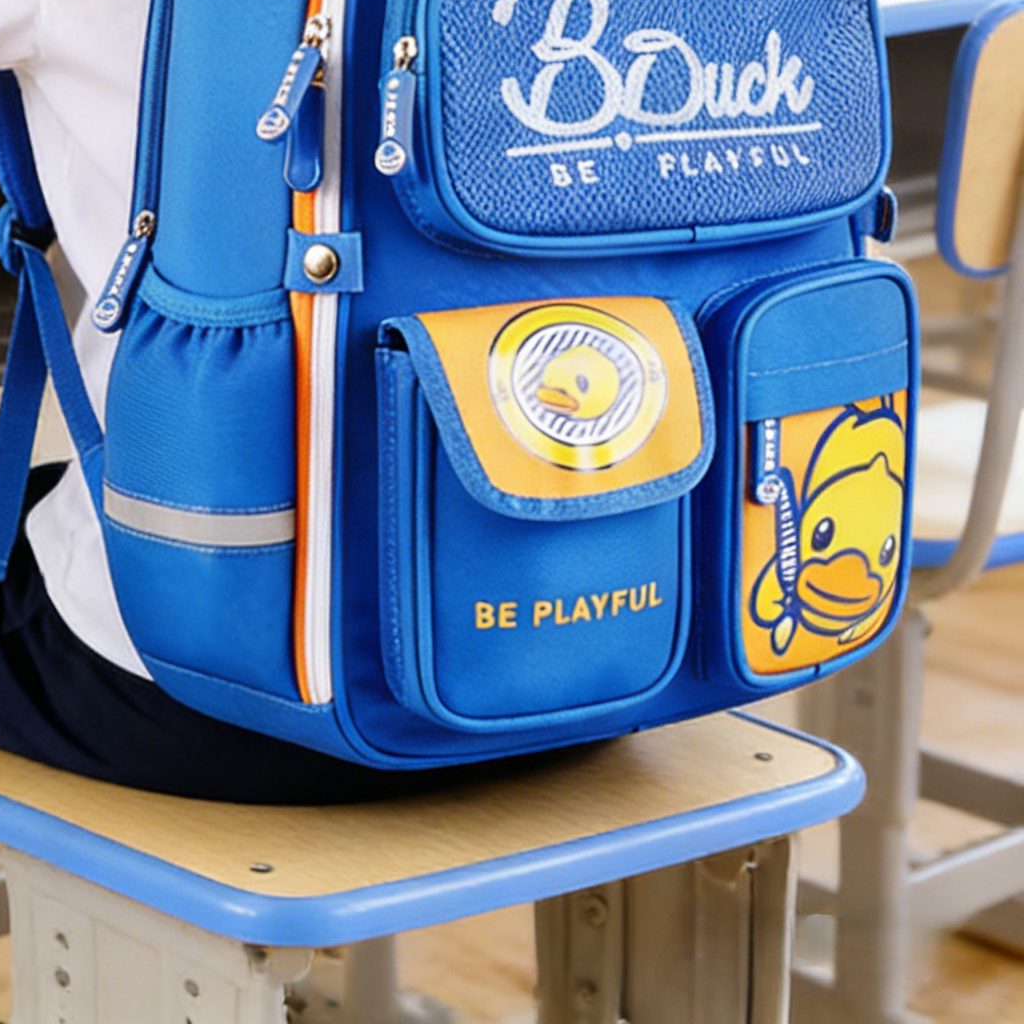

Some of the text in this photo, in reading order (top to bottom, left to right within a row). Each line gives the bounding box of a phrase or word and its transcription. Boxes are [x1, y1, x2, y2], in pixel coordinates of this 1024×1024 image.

[549, 159, 599, 187] BE
[474, 582, 663, 630] BE PLAYFUL
